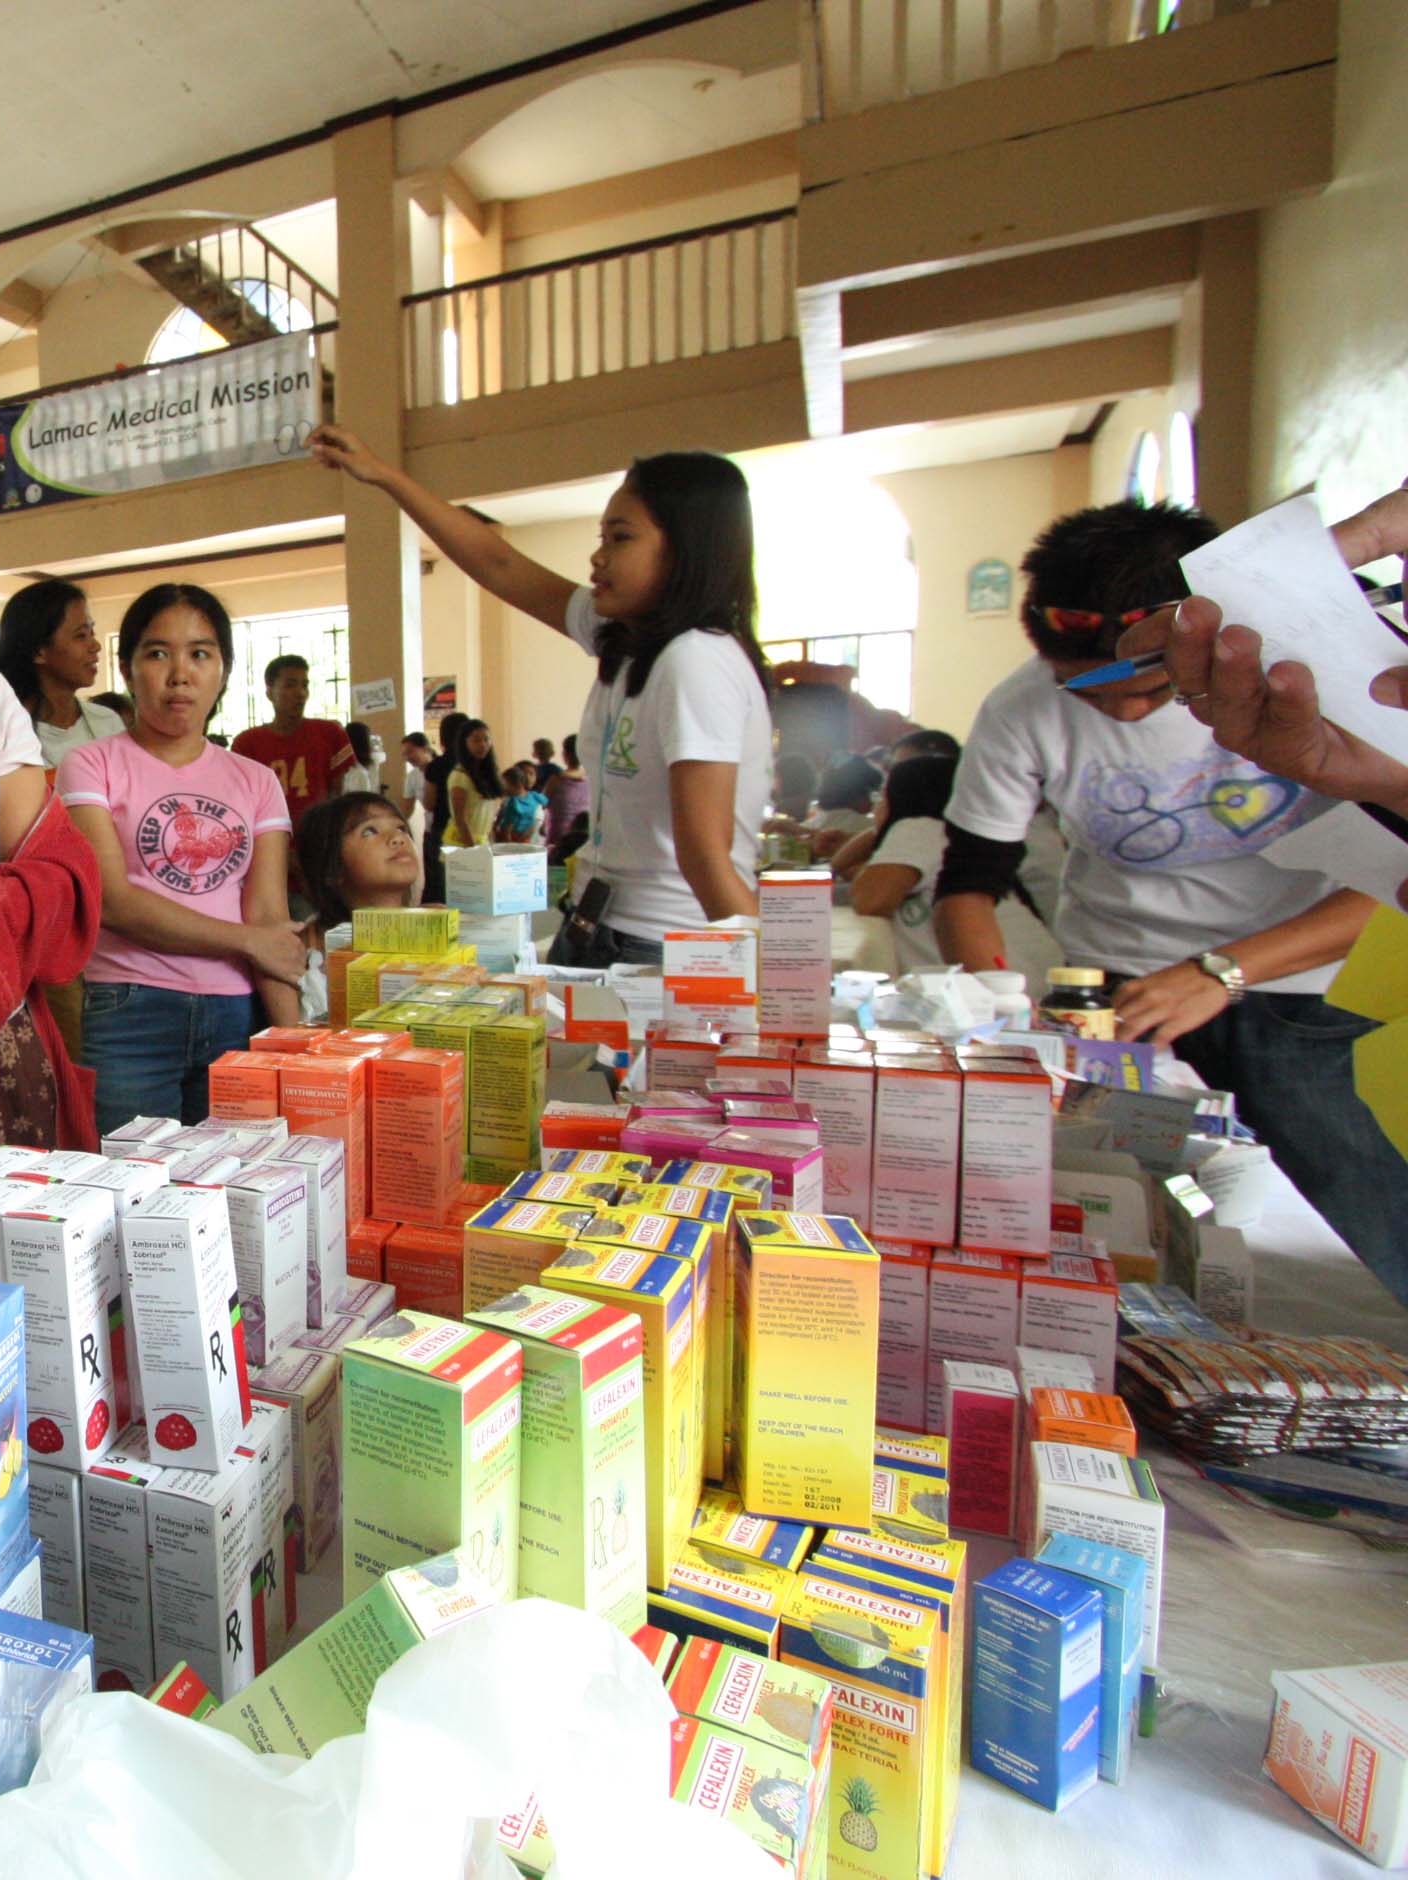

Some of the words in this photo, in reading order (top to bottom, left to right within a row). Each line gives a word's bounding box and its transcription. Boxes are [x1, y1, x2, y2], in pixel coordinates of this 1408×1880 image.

[28, 417, 97, 450] Lamac
[107, 392, 201, 433] Medical
[211, 369, 310, 409] Mission
[159, 799, 180, 815] ON
[195, 800, 228, 819] THE
[141, 817, 162, 855] KEEP
[157, 865, 192, 889] SIDE
[10, 1240, 45, 1251] Ambroxol
[132, 1240, 170, 1250] Ambroxol
[593, 1377, 636, 1416] CEFALEXIN
[377, 1527, 394, 1540] WELL
[844, 1535, 937, 1566] CEFALEXIN
[674, 1567, 763, 1603] CEFALEXIN
[814, 1584, 912, 1620] CEFALEXIN
[804, 1594, 872, 1622] PEDIAFLEX
[873, 1615, 915, 1632] FORTE
[722, 1661, 756, 1716] CEFALEXIN
[893, 1669, 911, 1682] mL
[831, 1686, 906, 1724] FALEXIN
[870, 1720, 910, 1745] FORTE
[832, 1741, 902, 1773] BACTERIAL
[699, 1744, 736, 1811] CEFALEXIN
[732, 1766, 756, 1812] PEDIAFLEX
